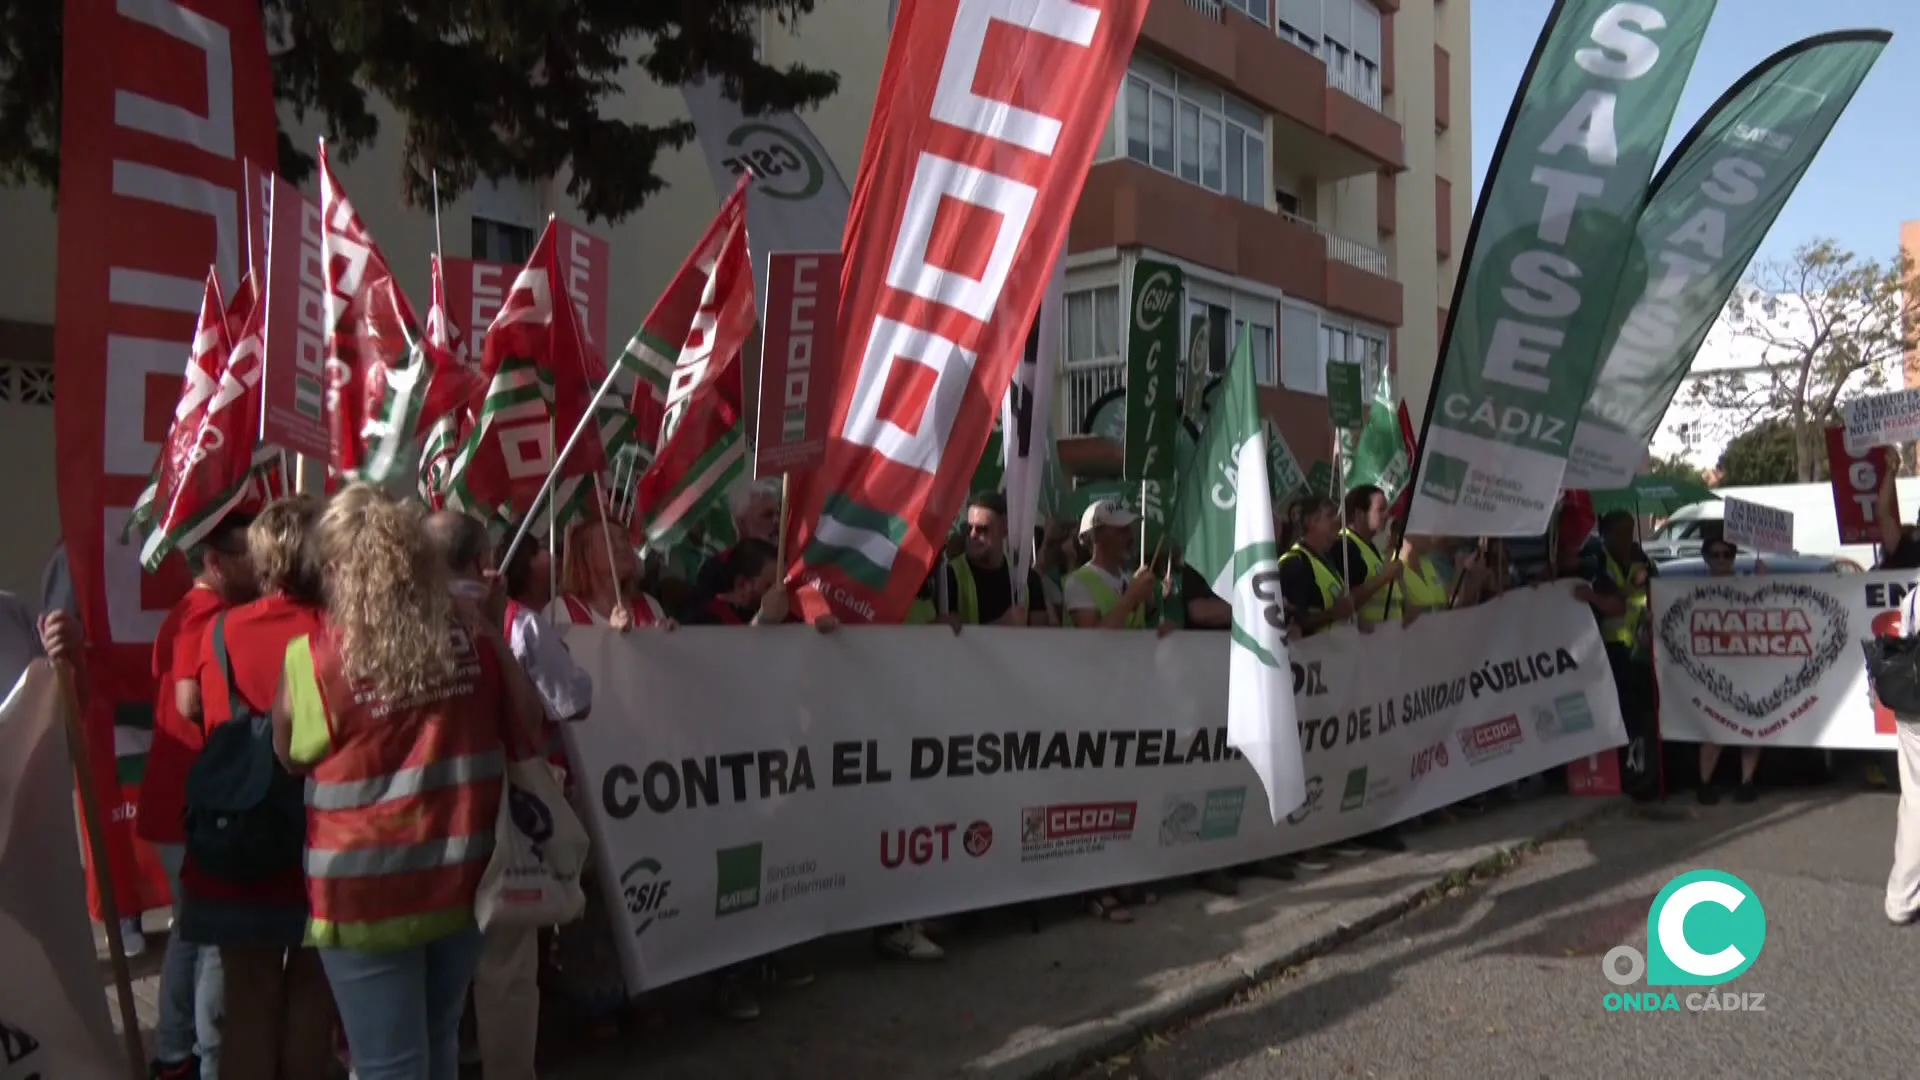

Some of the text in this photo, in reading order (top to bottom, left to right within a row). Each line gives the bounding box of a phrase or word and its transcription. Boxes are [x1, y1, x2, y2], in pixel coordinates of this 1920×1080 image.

[1482, 1, 1668, 394] SATSE
[1143, 285, 1175, 312] CSIF
[784, 257, 819, 411] CCOO
[1142, 340, 1163, 476] CSIF
[1444, 392, 1567, 446] CÁDIZ
[1691, 608, 1812, 632] MAREA
[1691, 632, 1813, 656] BLANCA
[601, 745, 816, 820] CONTRA
[832, 740, 893, 787] EL
[1345, 706, 1373, 746] DE
[1377, 699, 1398, 735] LA
[1401, 677, 1467, 726] SANIDAD
[1468, 647, 1580, 699] PÚBLICA
[1050, 807, 1115, 833] CCOO
[879, 822, 957, 870] UGT
[767, 858, 817, 883] Sindicato
